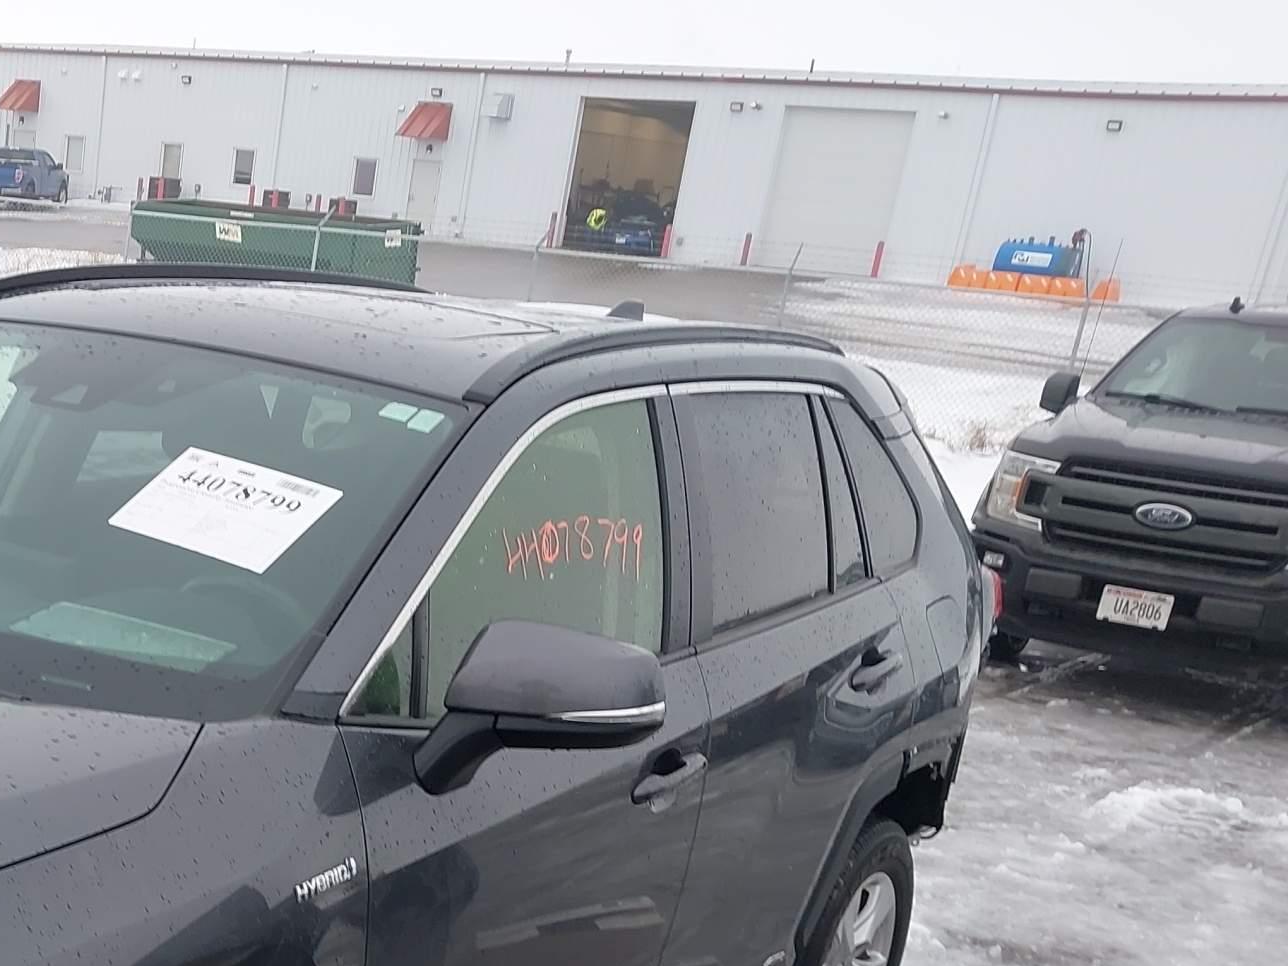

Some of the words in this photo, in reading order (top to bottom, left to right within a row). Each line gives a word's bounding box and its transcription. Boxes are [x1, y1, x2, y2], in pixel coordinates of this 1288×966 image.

[178, 469, 301, 516] 44078799
[503, 515, 643, 584] 44078799
[295, 862, 350, 903] HYBRID
